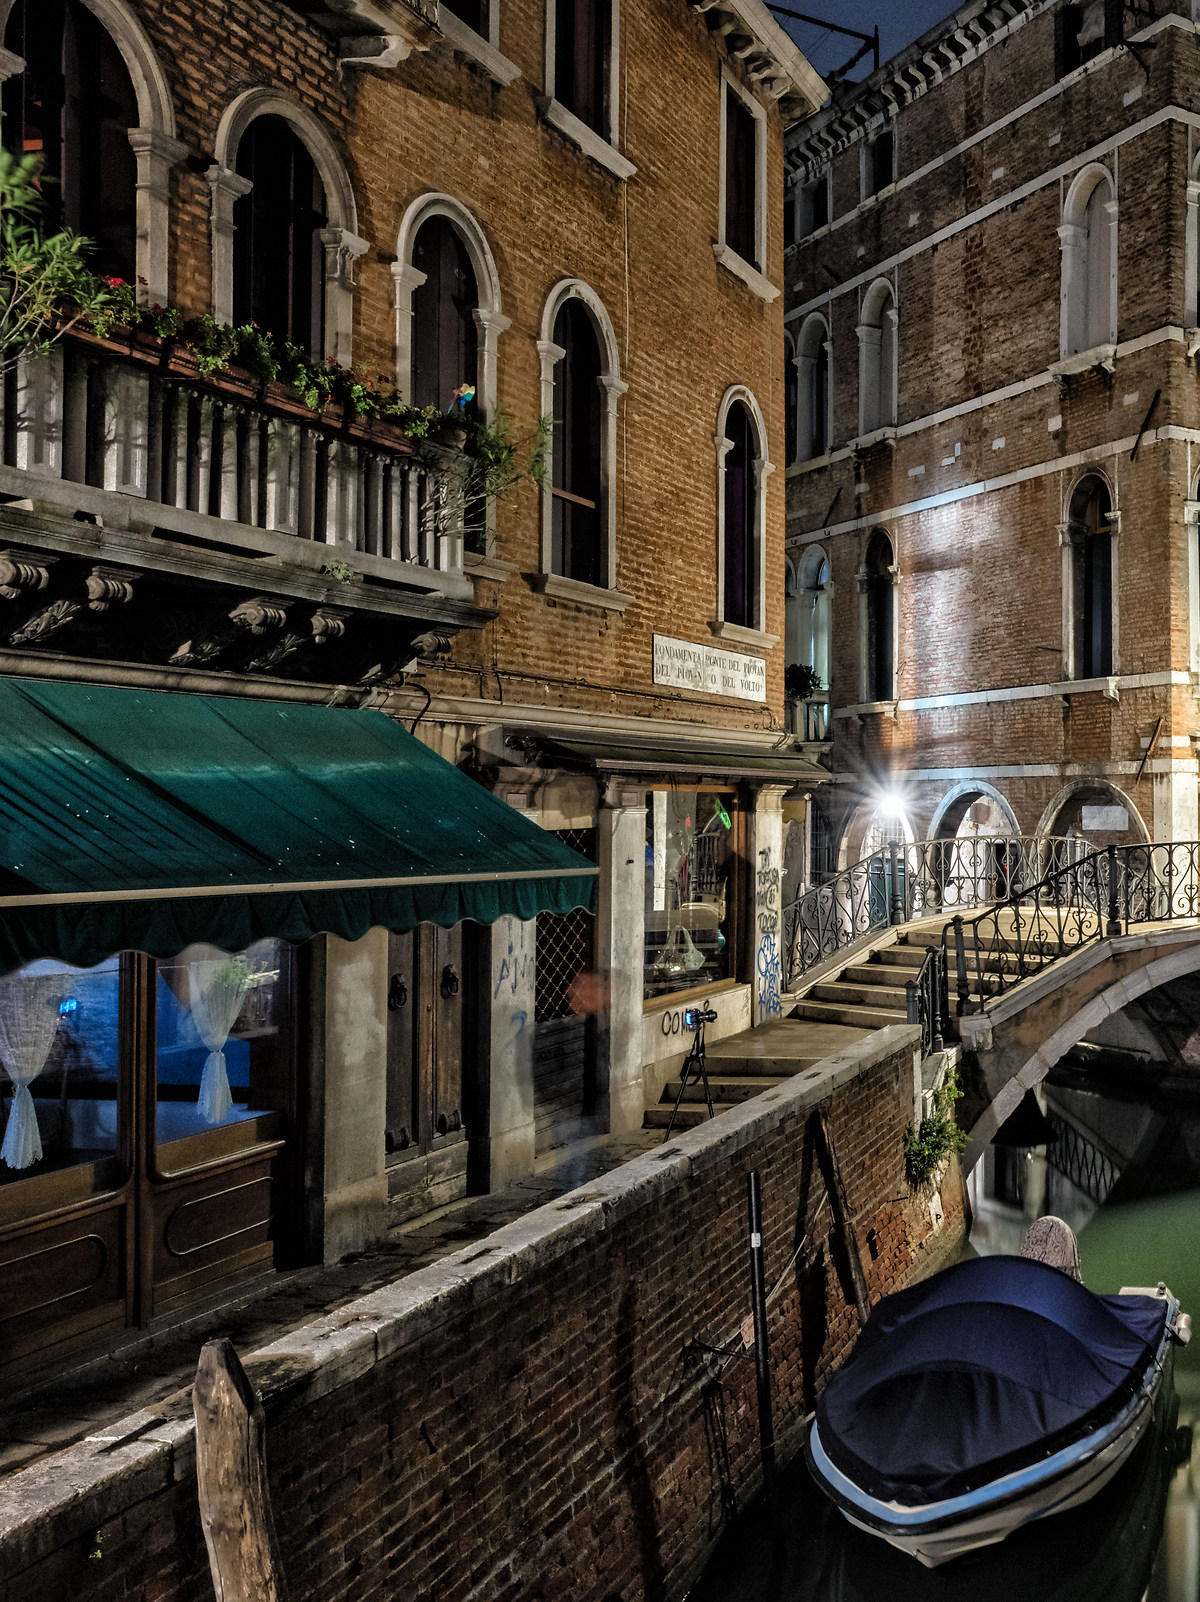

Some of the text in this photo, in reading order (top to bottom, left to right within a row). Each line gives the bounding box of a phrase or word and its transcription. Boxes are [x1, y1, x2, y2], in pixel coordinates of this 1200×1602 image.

[655, 644, 701, 663] FONDAMENTA
[655, 662, 702, 682] DEL PIOVN
[705, 654, 765, 677] PONTE DEL PIOVAN
[710, 674, 760, 693] O DEL VOLTO
